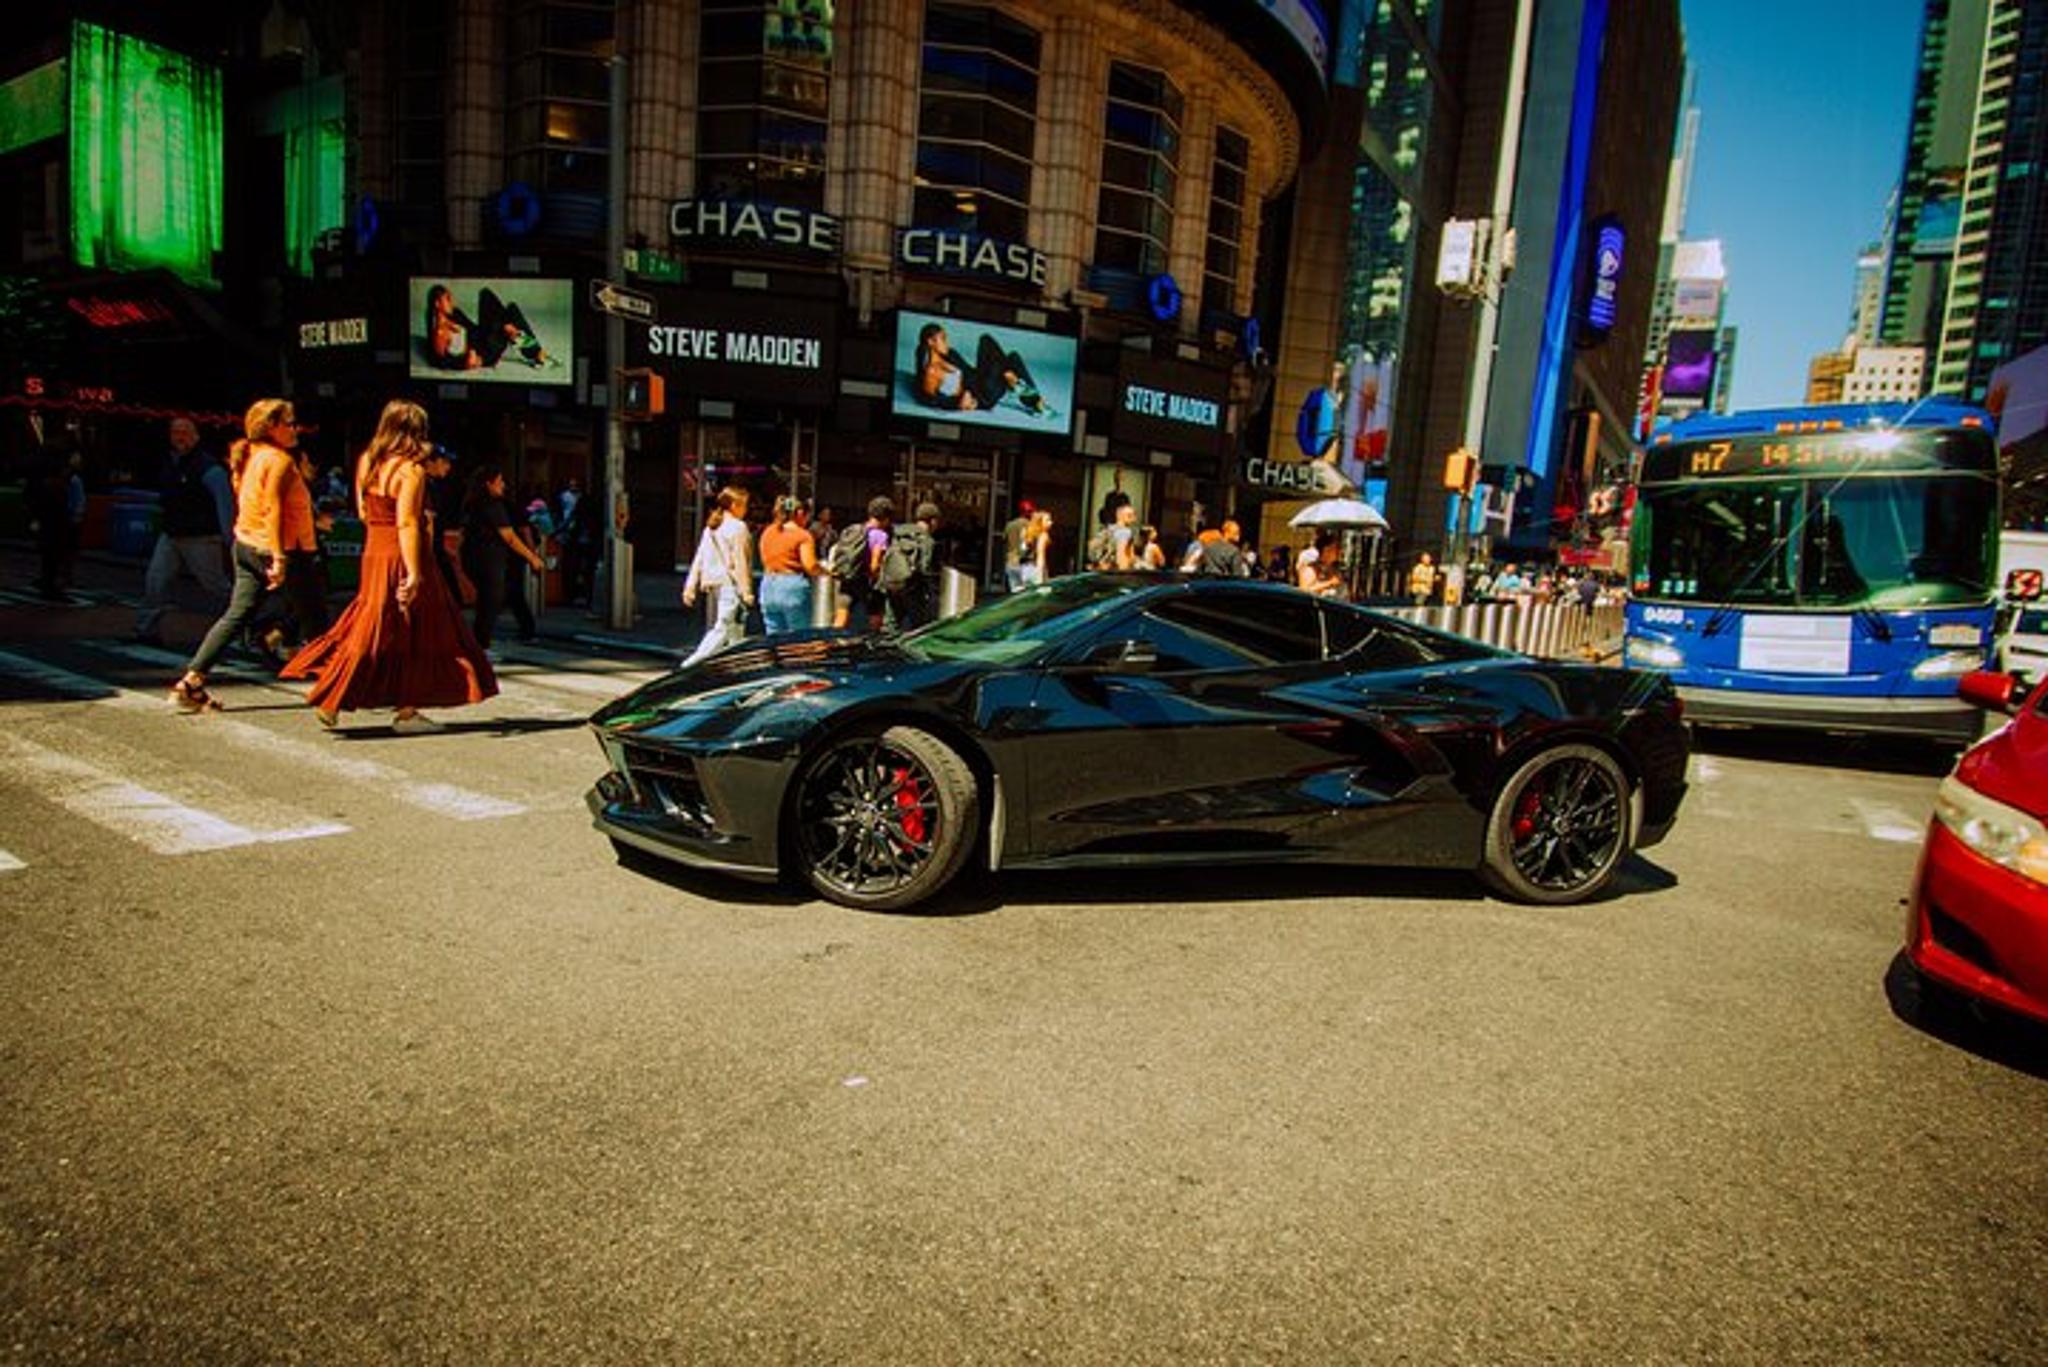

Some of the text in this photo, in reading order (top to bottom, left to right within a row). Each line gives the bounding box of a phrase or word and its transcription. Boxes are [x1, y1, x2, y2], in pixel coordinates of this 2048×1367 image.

[669, 201, 838, 252] CHASE
[902, 229, 1046, 287] CHASE
[299, 320, 326, 349] STEVE
[648, 325, 821, 369] STEVE MADDEN
[1125, 385, 1166, 417] STEVE
[1247, 458, 1326, 491] CHASE
